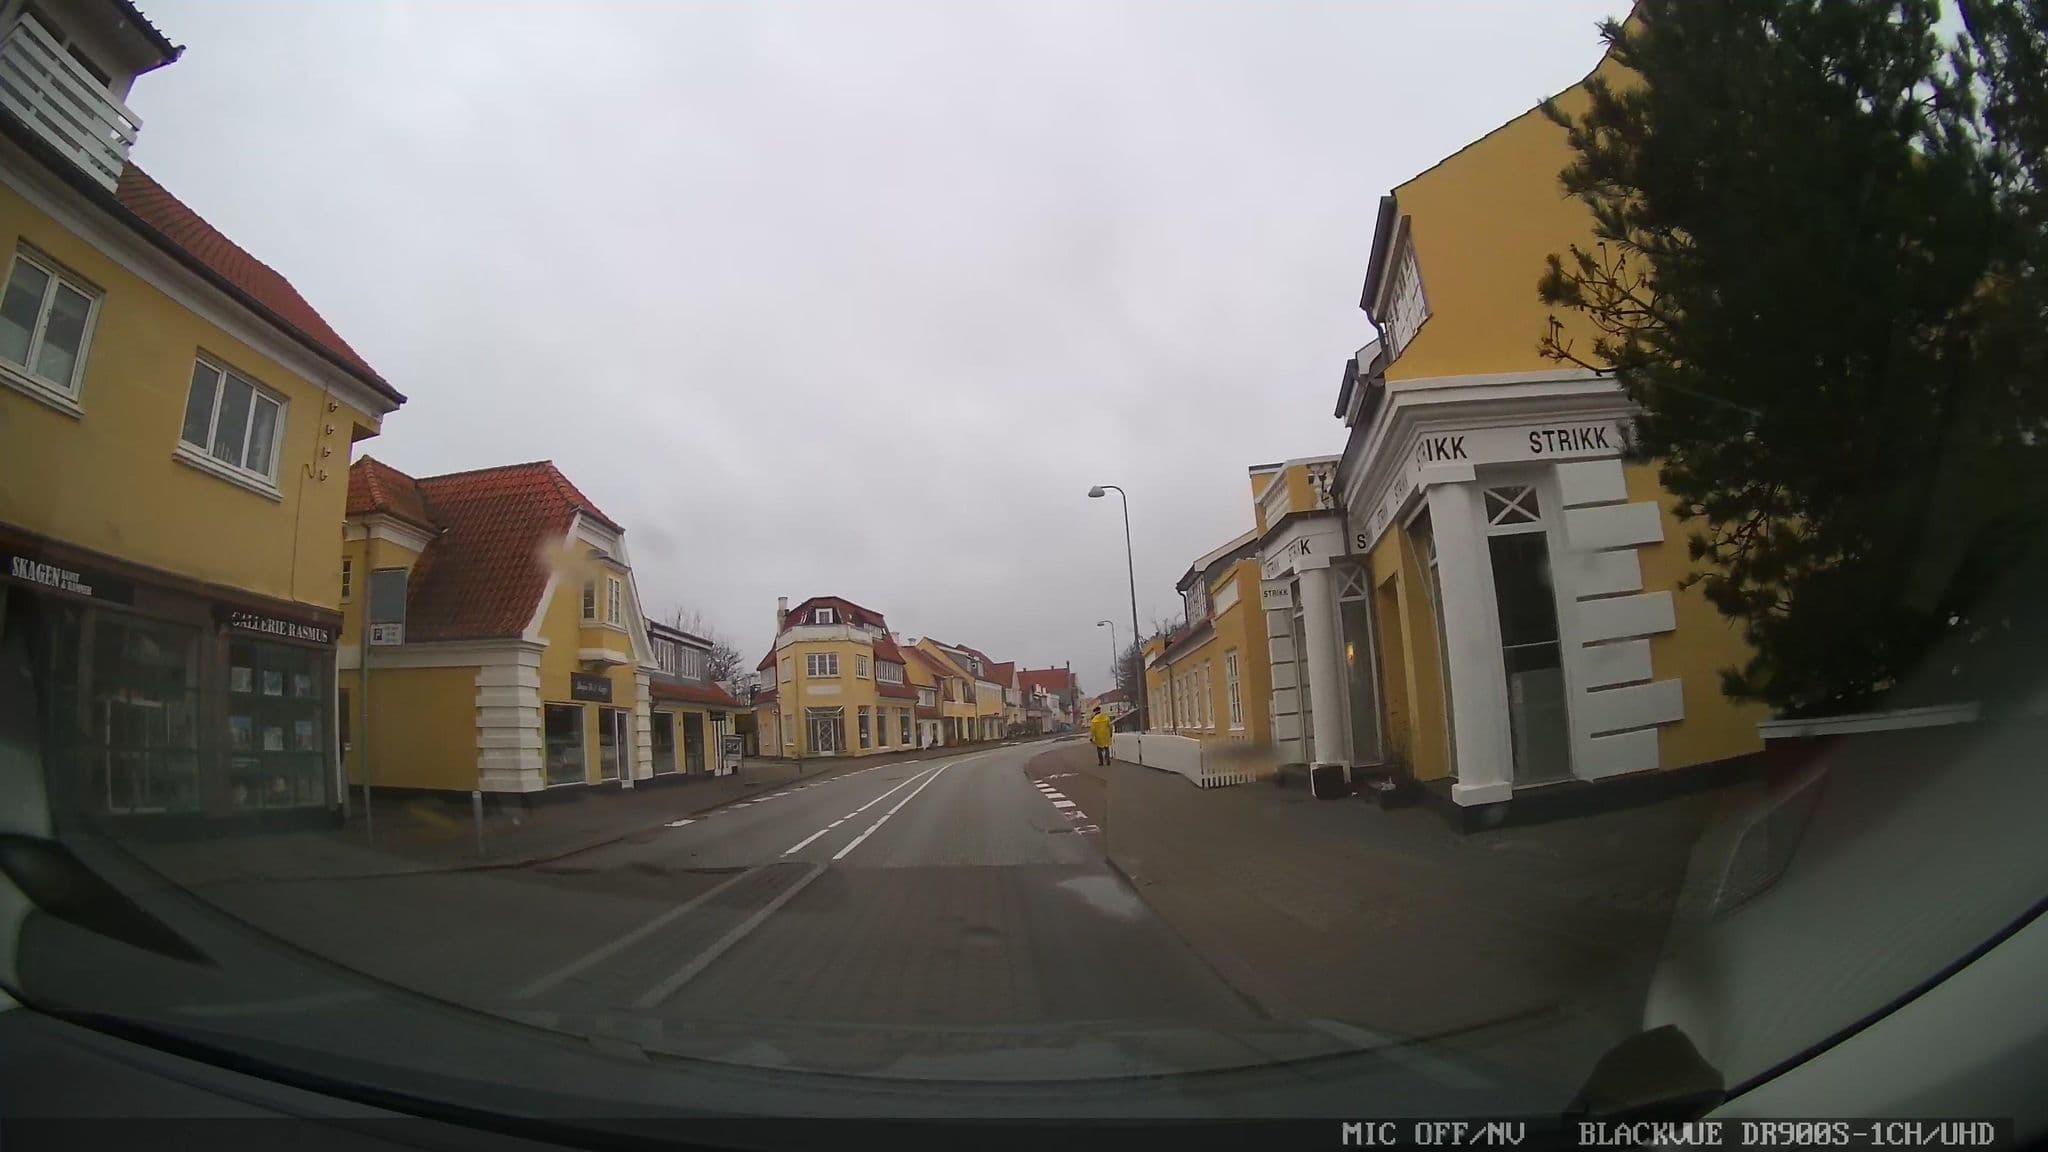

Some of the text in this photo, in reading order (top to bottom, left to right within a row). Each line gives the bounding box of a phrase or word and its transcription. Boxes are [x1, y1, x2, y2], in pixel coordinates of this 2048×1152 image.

[1418, 436, 1468, 465] IKK
[1529, 427, 1610, 453] STRIKK
[12, 556, 61, 587] SKAGEN
[288, 623, 328, 642] RASMUS
